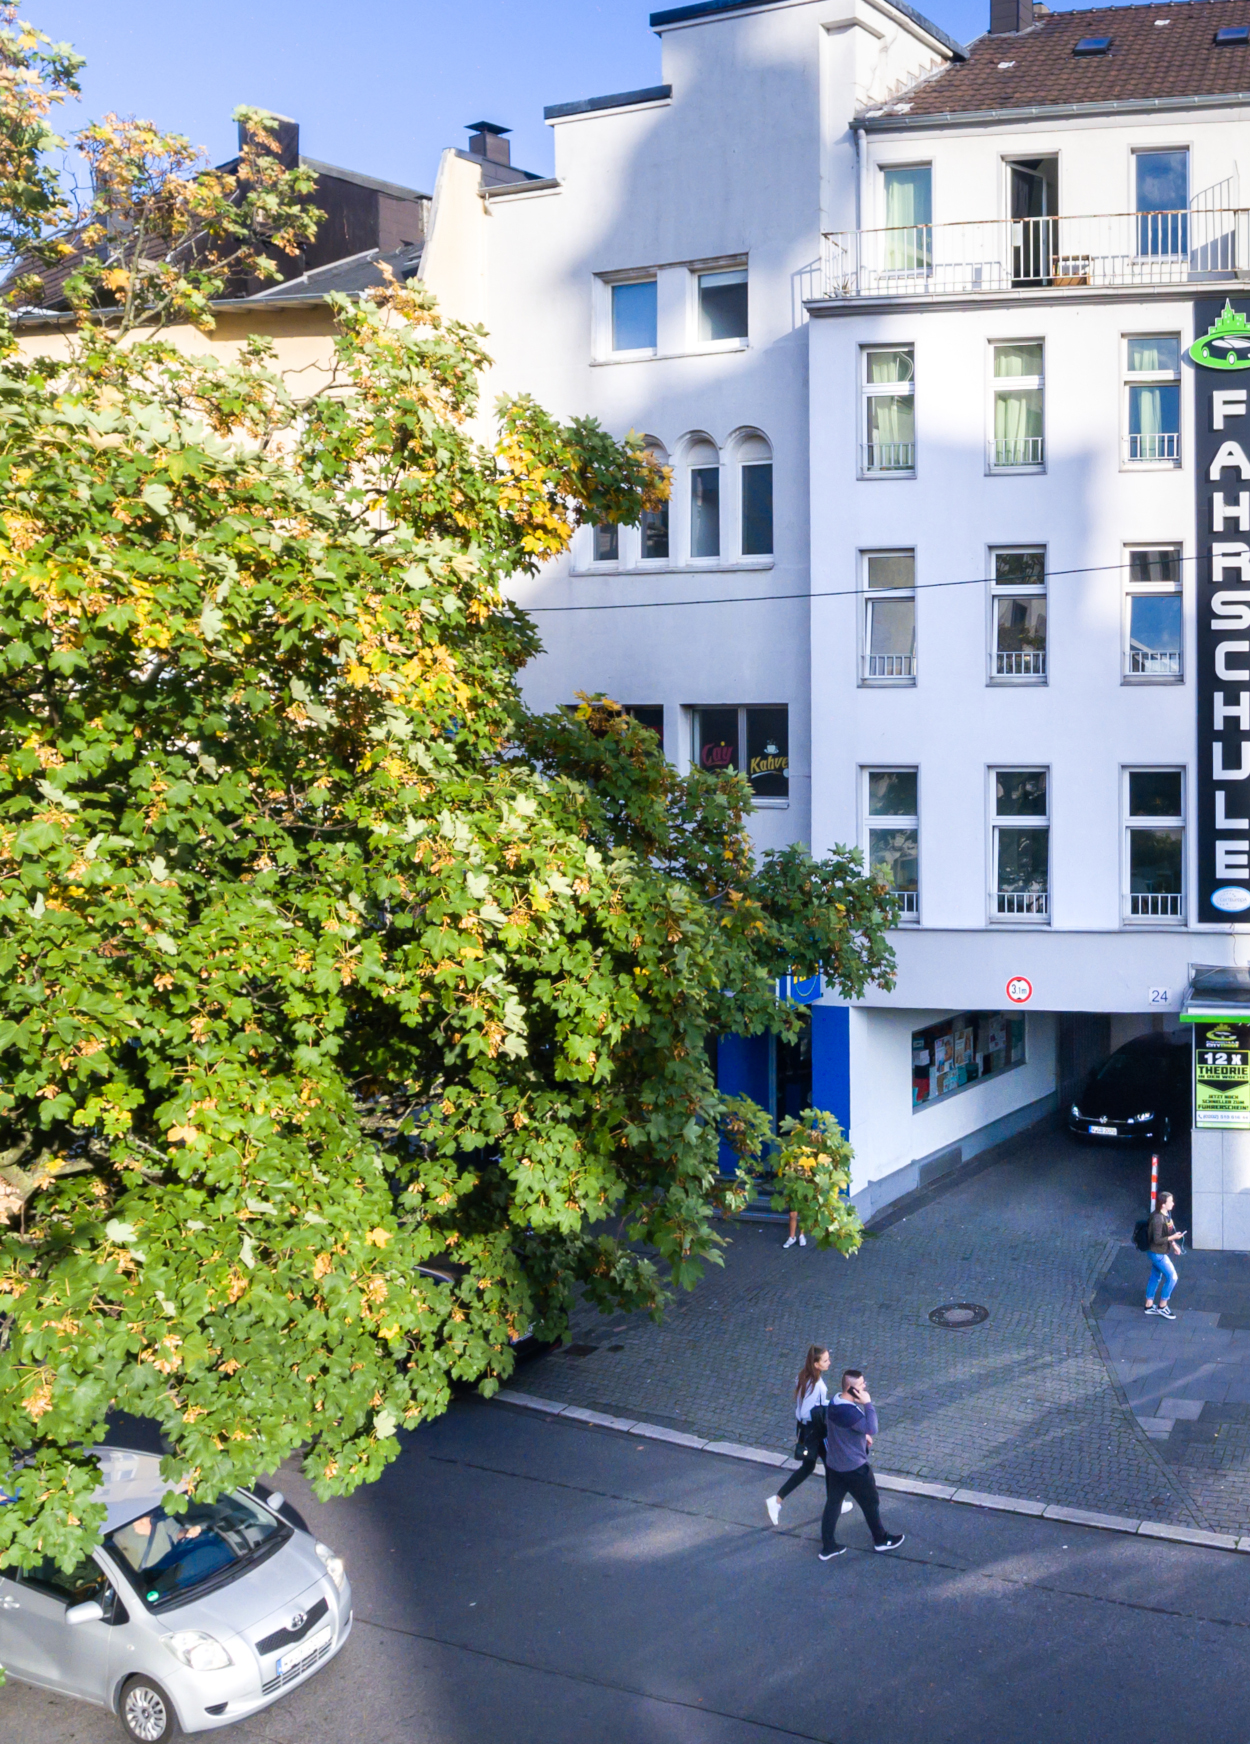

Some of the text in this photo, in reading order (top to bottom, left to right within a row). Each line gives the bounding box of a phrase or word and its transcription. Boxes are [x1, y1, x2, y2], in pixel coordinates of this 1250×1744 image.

[750, 754, 788, 774] Kahve
[1151, 990, 1169, 1003] 24
[1204, 1052, 1228, 1065] 12
[1198, 1066, 1248, 1075] THEORIE
